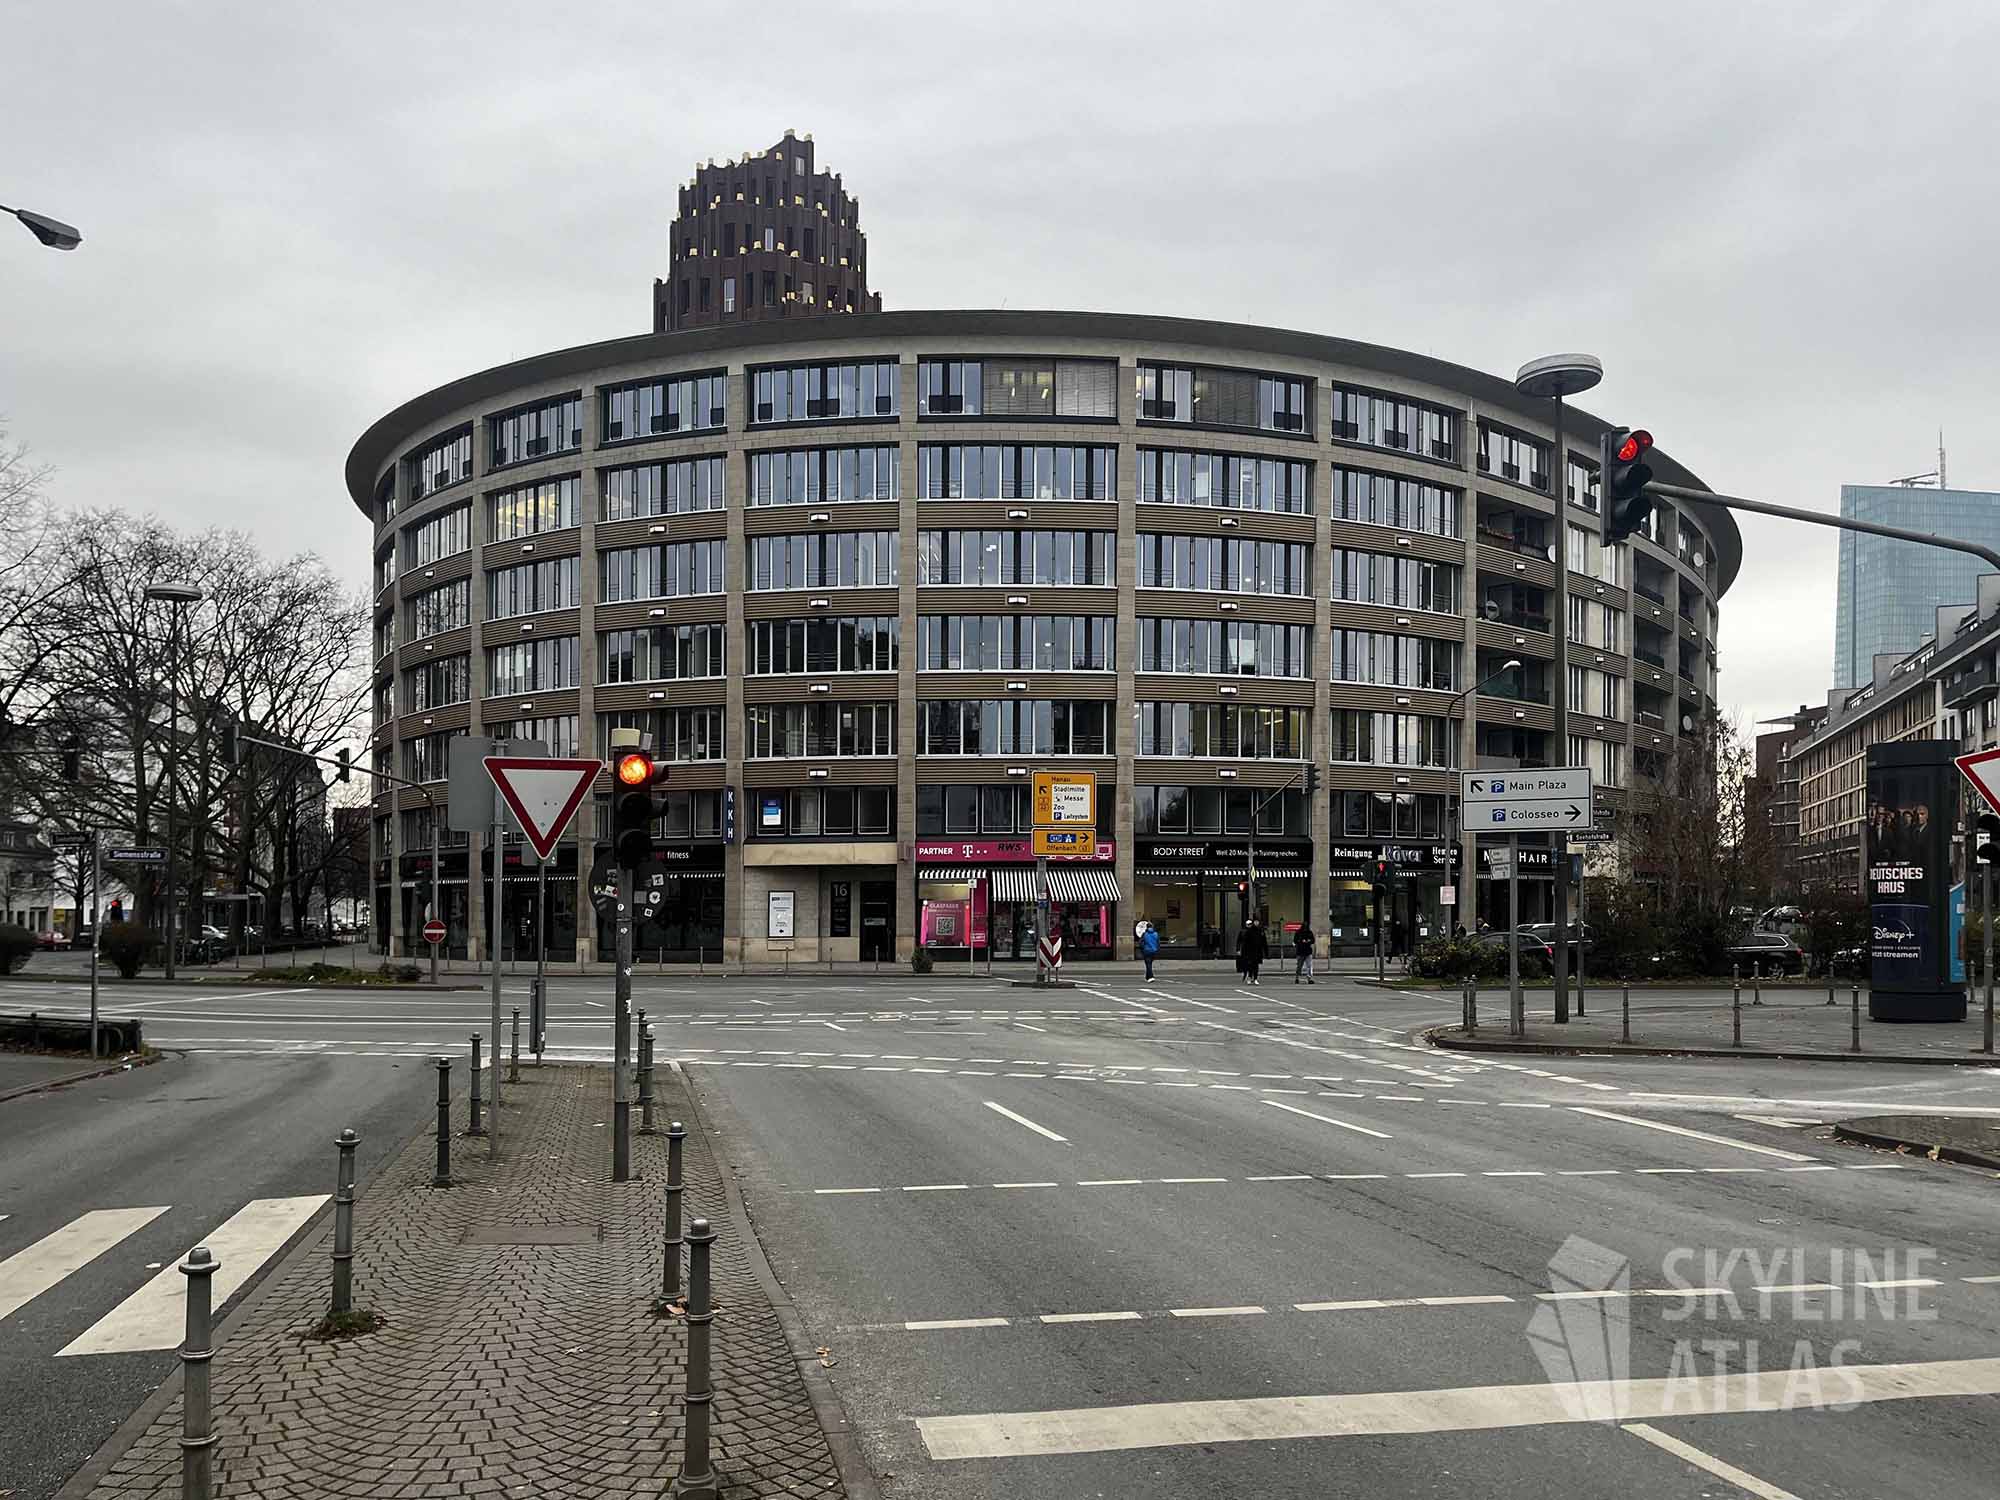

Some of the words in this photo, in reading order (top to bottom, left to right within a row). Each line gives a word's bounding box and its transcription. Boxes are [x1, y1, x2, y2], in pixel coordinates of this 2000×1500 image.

[1509, 782, 1534, 791] Main
[1538, 780, 1567, 790] Plaza
[1510, 809, 1560, 820] Colosseo
[667, 851, 689, 859] fitness
[919, 847, 953, 855] PARTNER
[1153, 847, 1176, 856] BODY
[1178, 847, 1204, 856] STREET
[1334, 847, 1373, 859] Reinigung
[1433, 855, 1457, 864] Serce
[1518, 851, 1548, 864] HAIR
[833, 883, 848, 897] 16
[1877, 881, 1905, 894] HAUS
[1883, 951, 1919, 959] streamen
